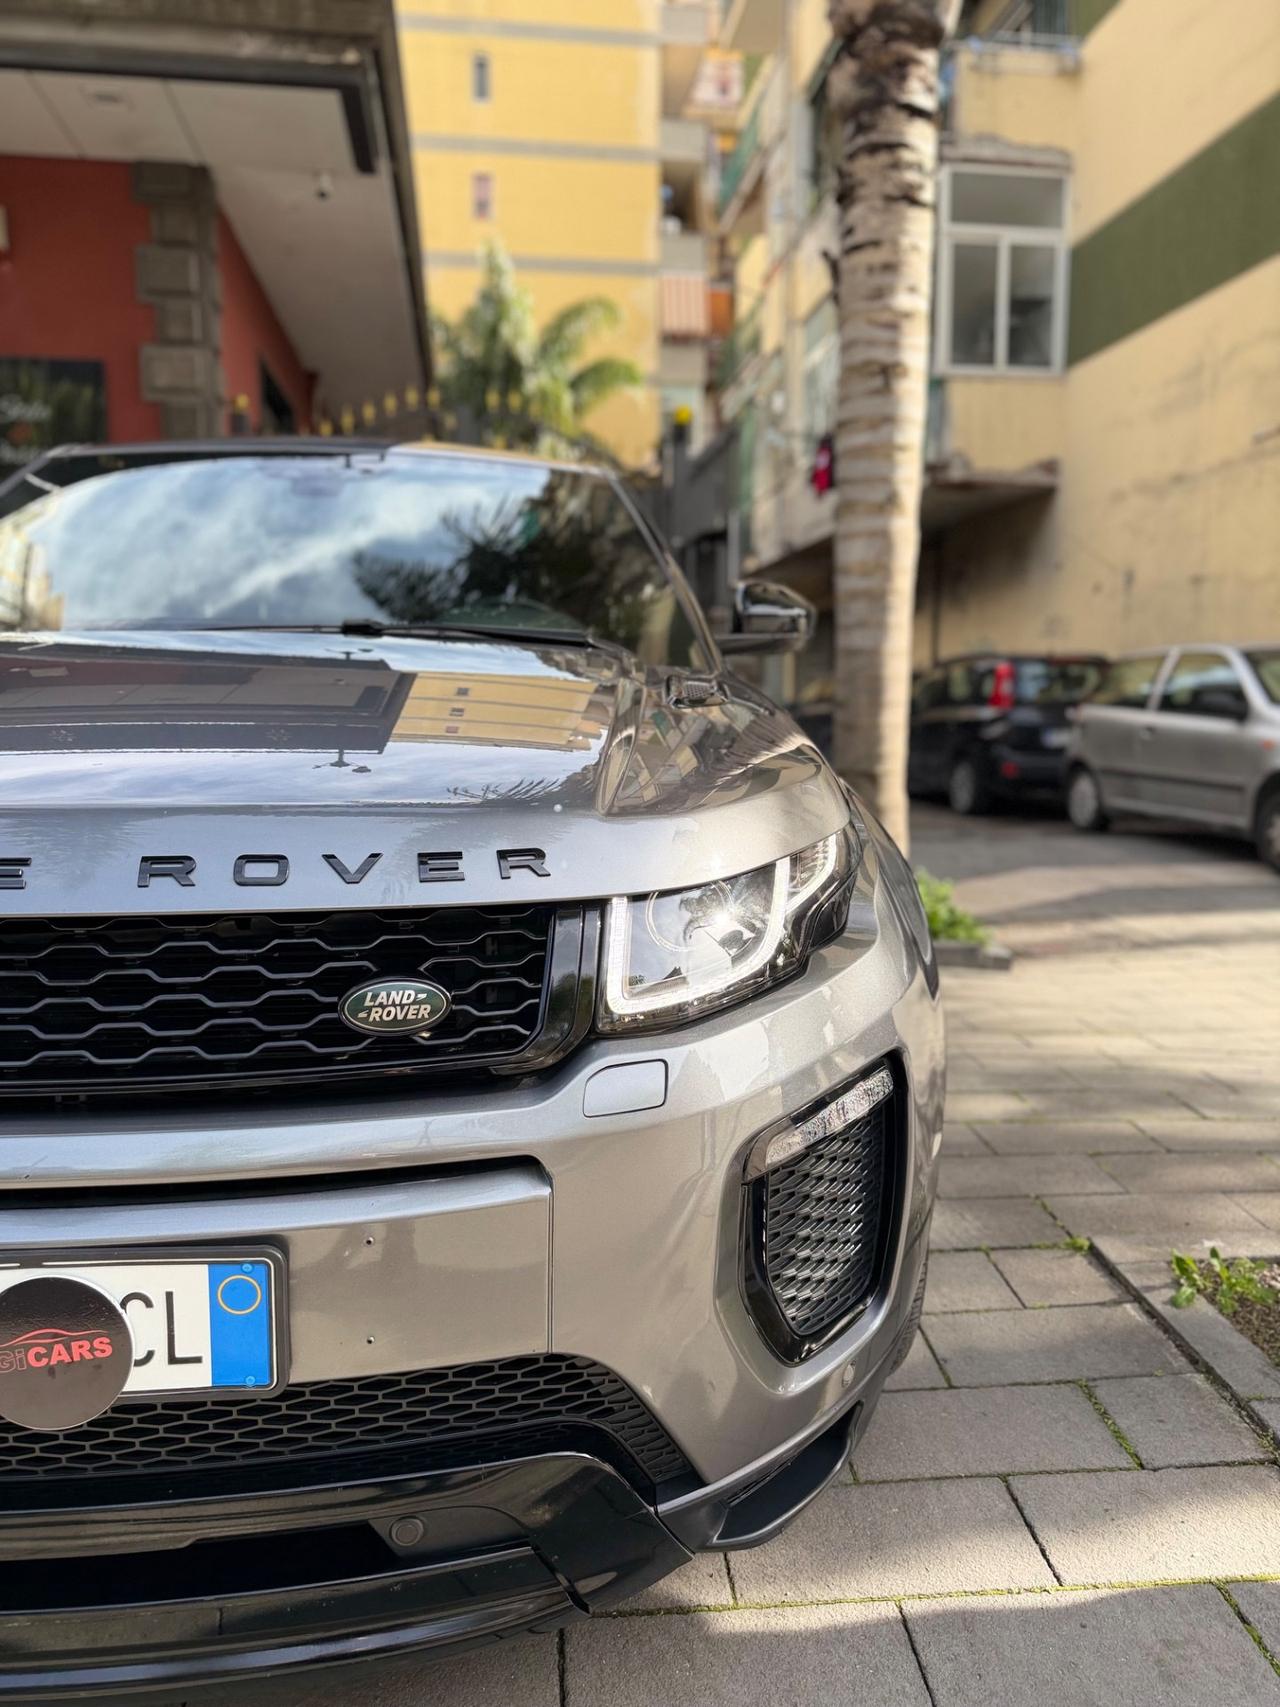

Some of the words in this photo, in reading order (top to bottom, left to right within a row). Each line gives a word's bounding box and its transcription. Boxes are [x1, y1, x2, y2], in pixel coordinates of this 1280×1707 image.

[137, 847, 551, 888] ROVER
[364, 990, 416, 1007] LAND
[368, 1004, 431, 1022] ROVER
